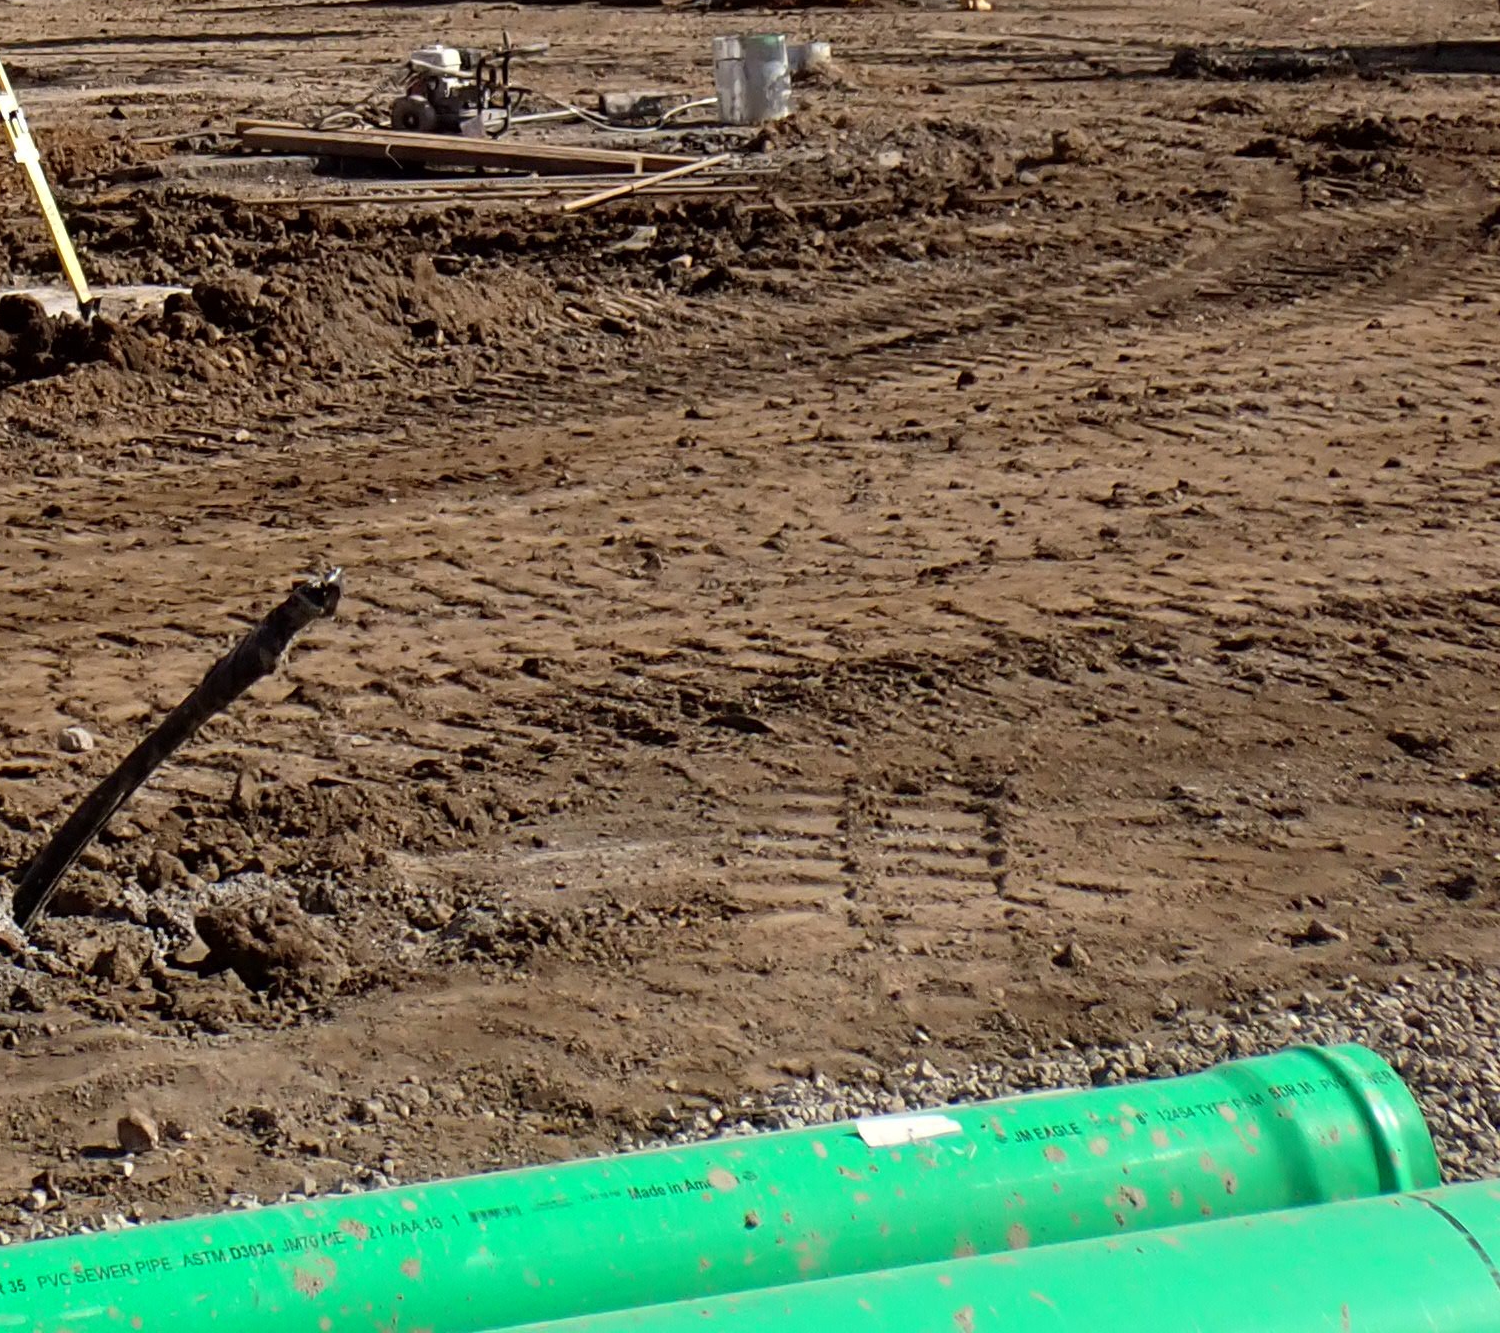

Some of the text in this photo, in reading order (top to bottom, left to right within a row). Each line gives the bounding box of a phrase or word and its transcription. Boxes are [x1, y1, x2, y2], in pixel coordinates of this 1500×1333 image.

[1013, 1128, 1034, 1144] JM
[1035, 1122, 1083, 1141] EAGLE
[8, 1278, 27, 1294] 35
[37, 1271, 72, 1290] PVC
[75, 1263, 134, 1285] SEWER
[134, 1257, 173, 1275] PIPE
[182, 1248, 228, 1269] ASTM
[230, 1242, 275, 1262] D3034
[628, 1184, 666, 1200] Made
[667, 1182, 684, 1195] in
